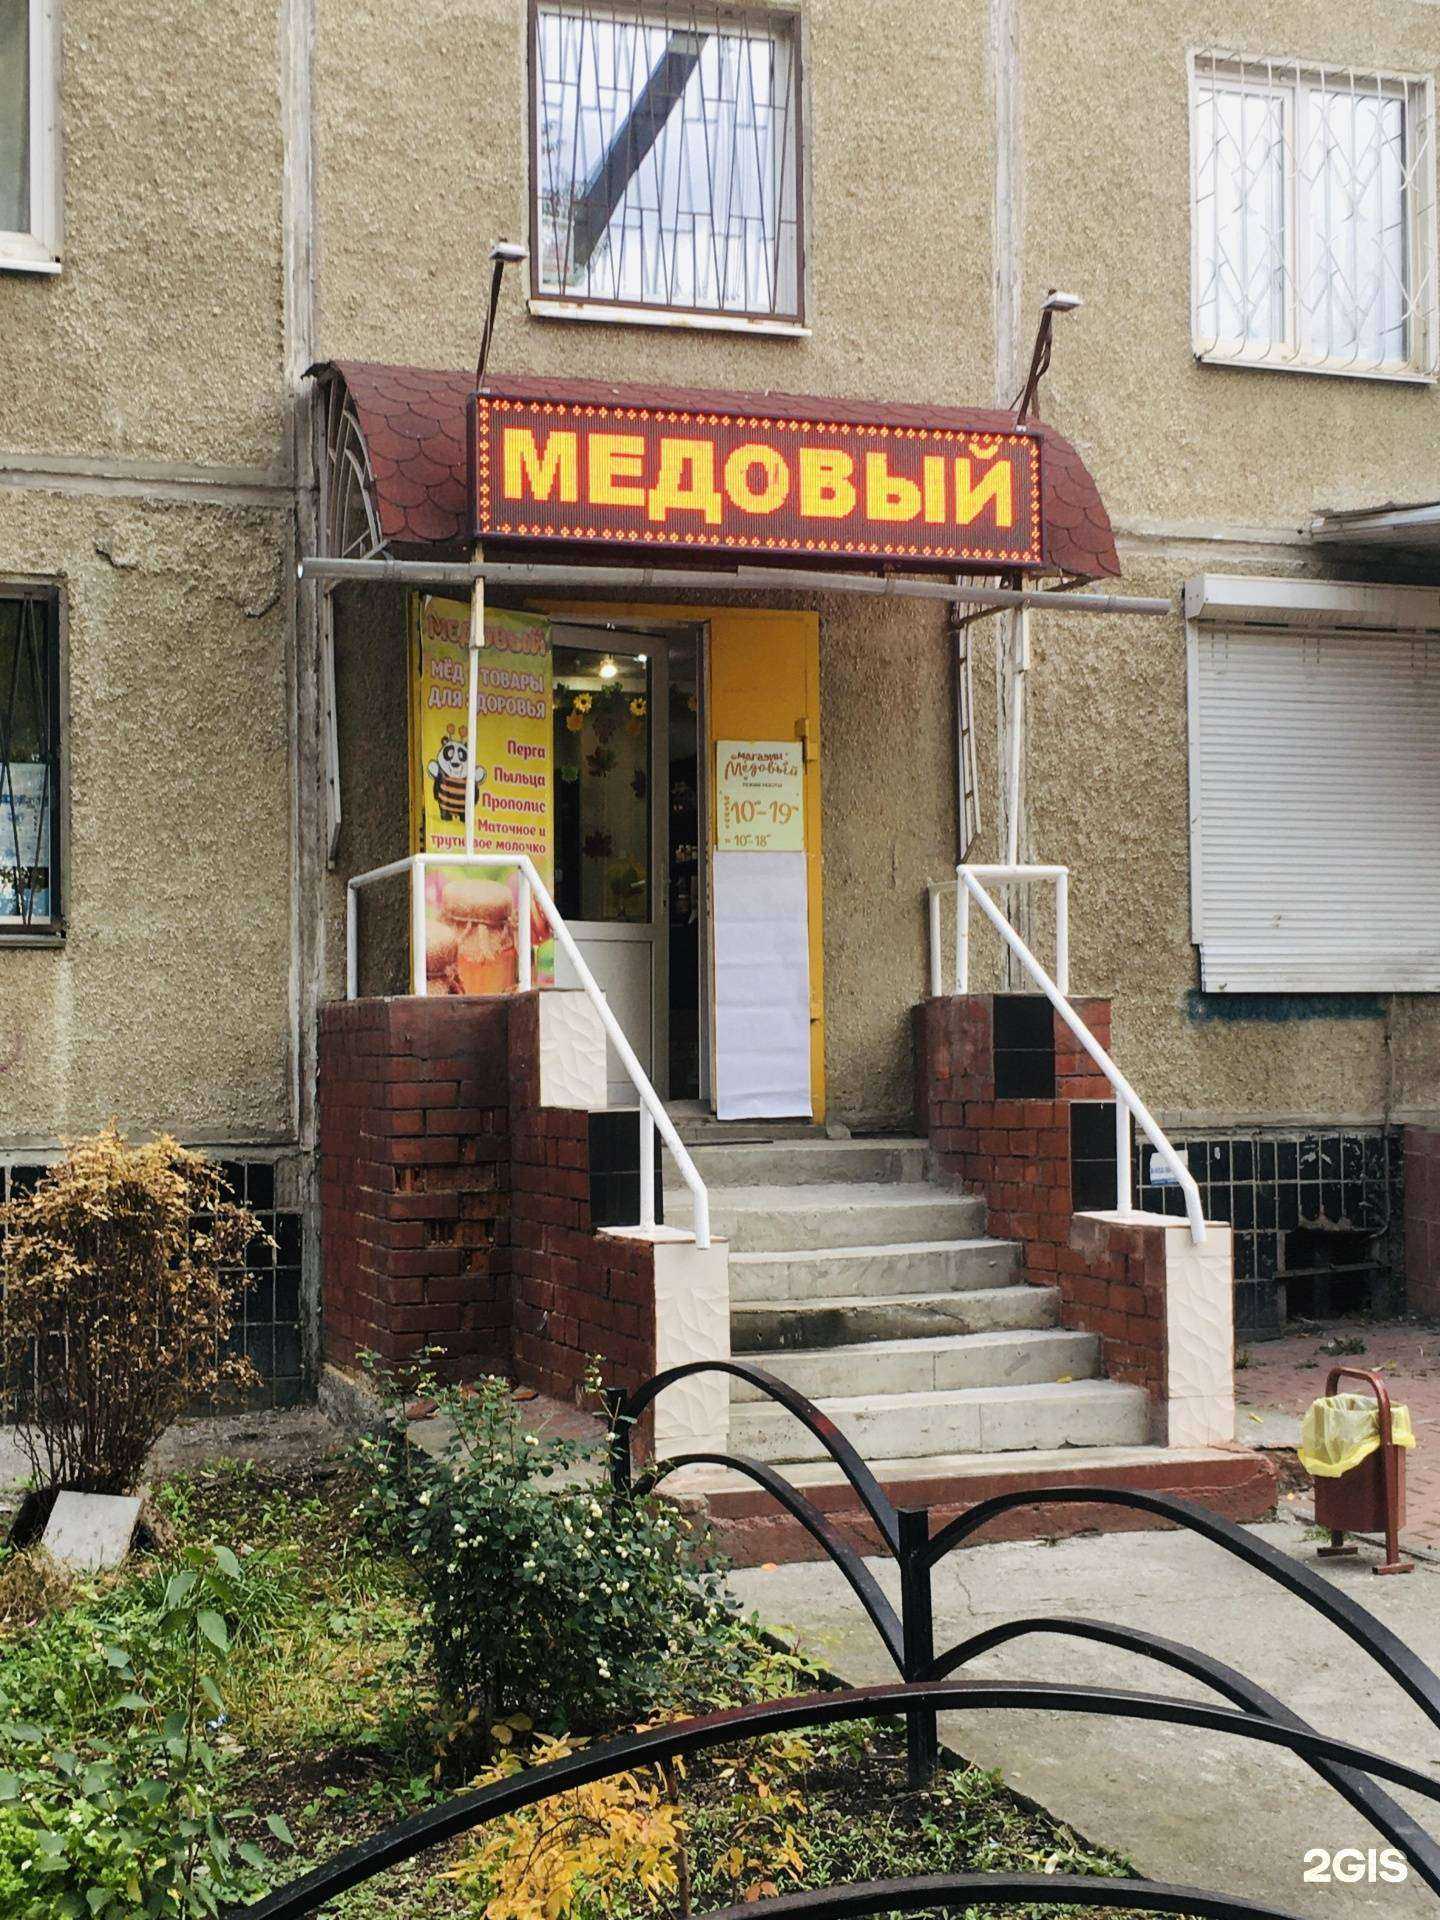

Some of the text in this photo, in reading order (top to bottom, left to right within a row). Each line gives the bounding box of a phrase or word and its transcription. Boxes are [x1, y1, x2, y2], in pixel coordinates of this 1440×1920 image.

[503, 427, 1013, 528] МЕДОВЫЙ
[431, 657, 464, 686] МЁД
[479, 668, 545, 693] ТОВАРЫ
[428, 686, 546, 718] ДЛЯ ДОРОВЬЯ
[507, 740, 546, 760] Перга
[494, 767, 546, 787] Пыльца
[482, 793, 546, 813] Прополис
[477, 818, 546, 837] Маточное и
[431, 834, 546, 853] трутнвое молочко
